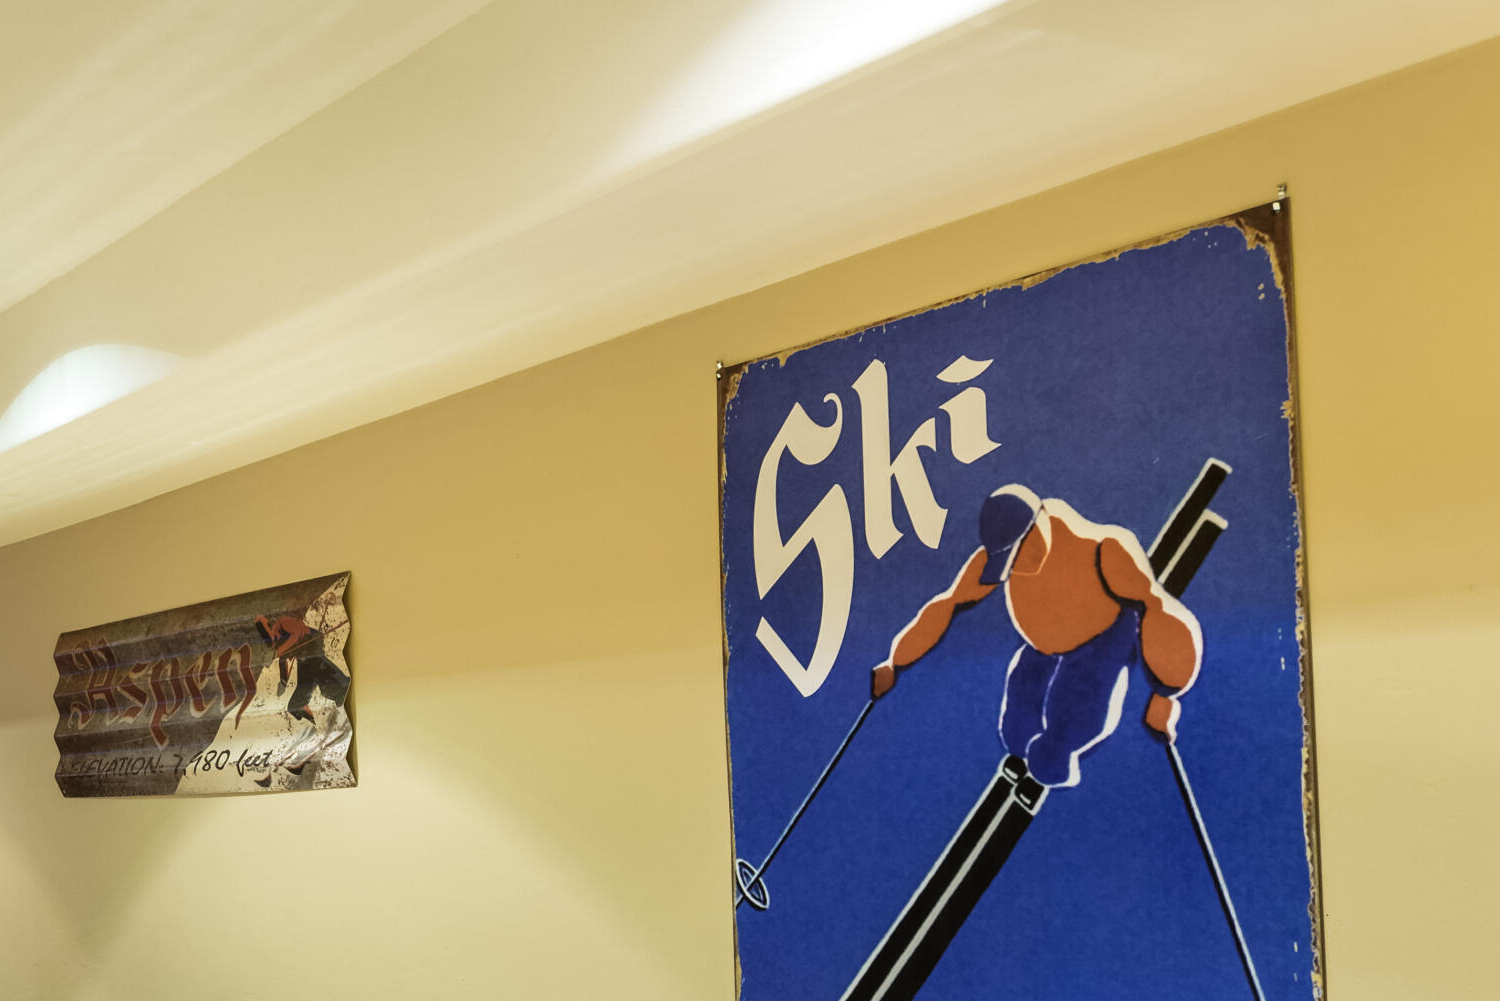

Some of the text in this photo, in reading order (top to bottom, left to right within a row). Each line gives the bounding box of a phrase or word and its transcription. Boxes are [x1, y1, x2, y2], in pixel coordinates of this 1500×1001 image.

[753, 354, 1002, 698] Ski
[68, 636, 257, 749] Aspen
[236, 749, 273, 777] feet
